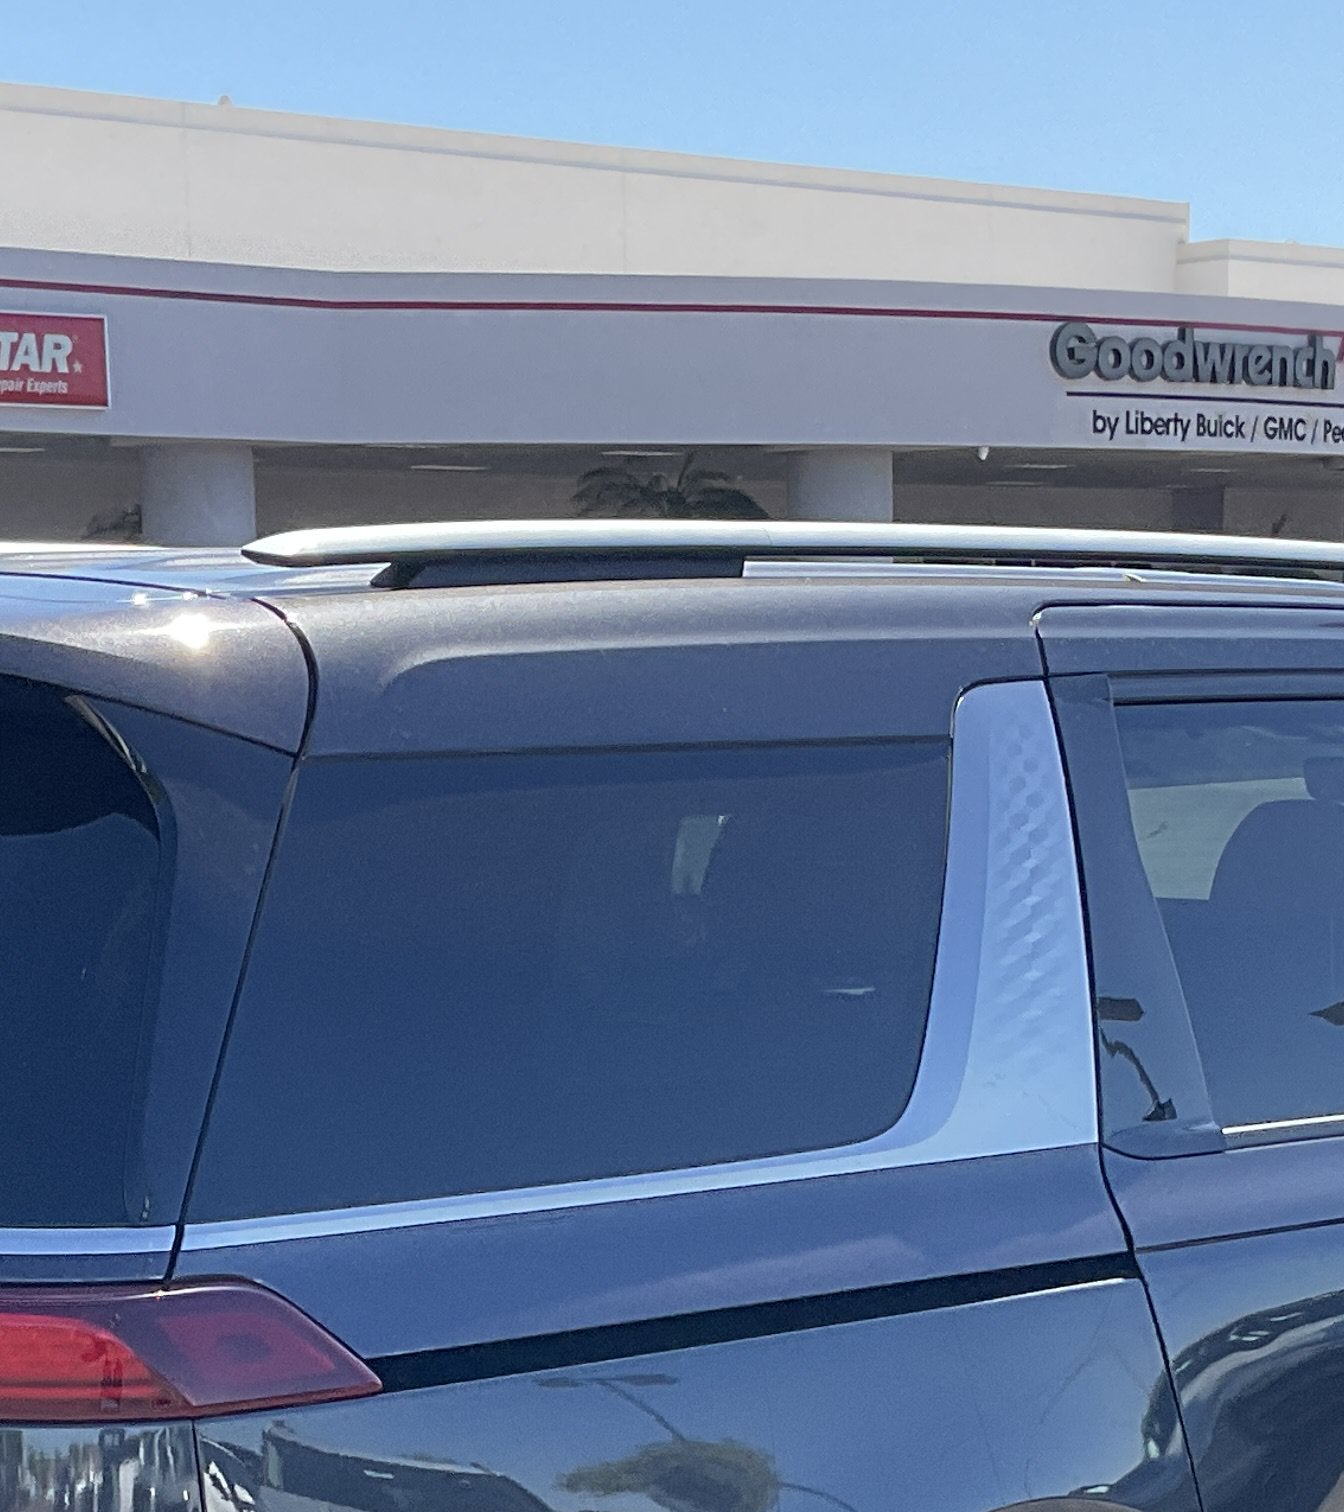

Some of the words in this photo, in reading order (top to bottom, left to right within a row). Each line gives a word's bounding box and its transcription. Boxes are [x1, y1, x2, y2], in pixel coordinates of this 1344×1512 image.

[1050, 322, 1335, 390] Goodwrench
[27, 378, 68, 396] Experts
[1092, 410, 1119, 440] by
[1125, 410, 1191, 441] Liberty
[1196, 413, 1246, 439] Buick
[1263, 416, 1307, 441] GMC
